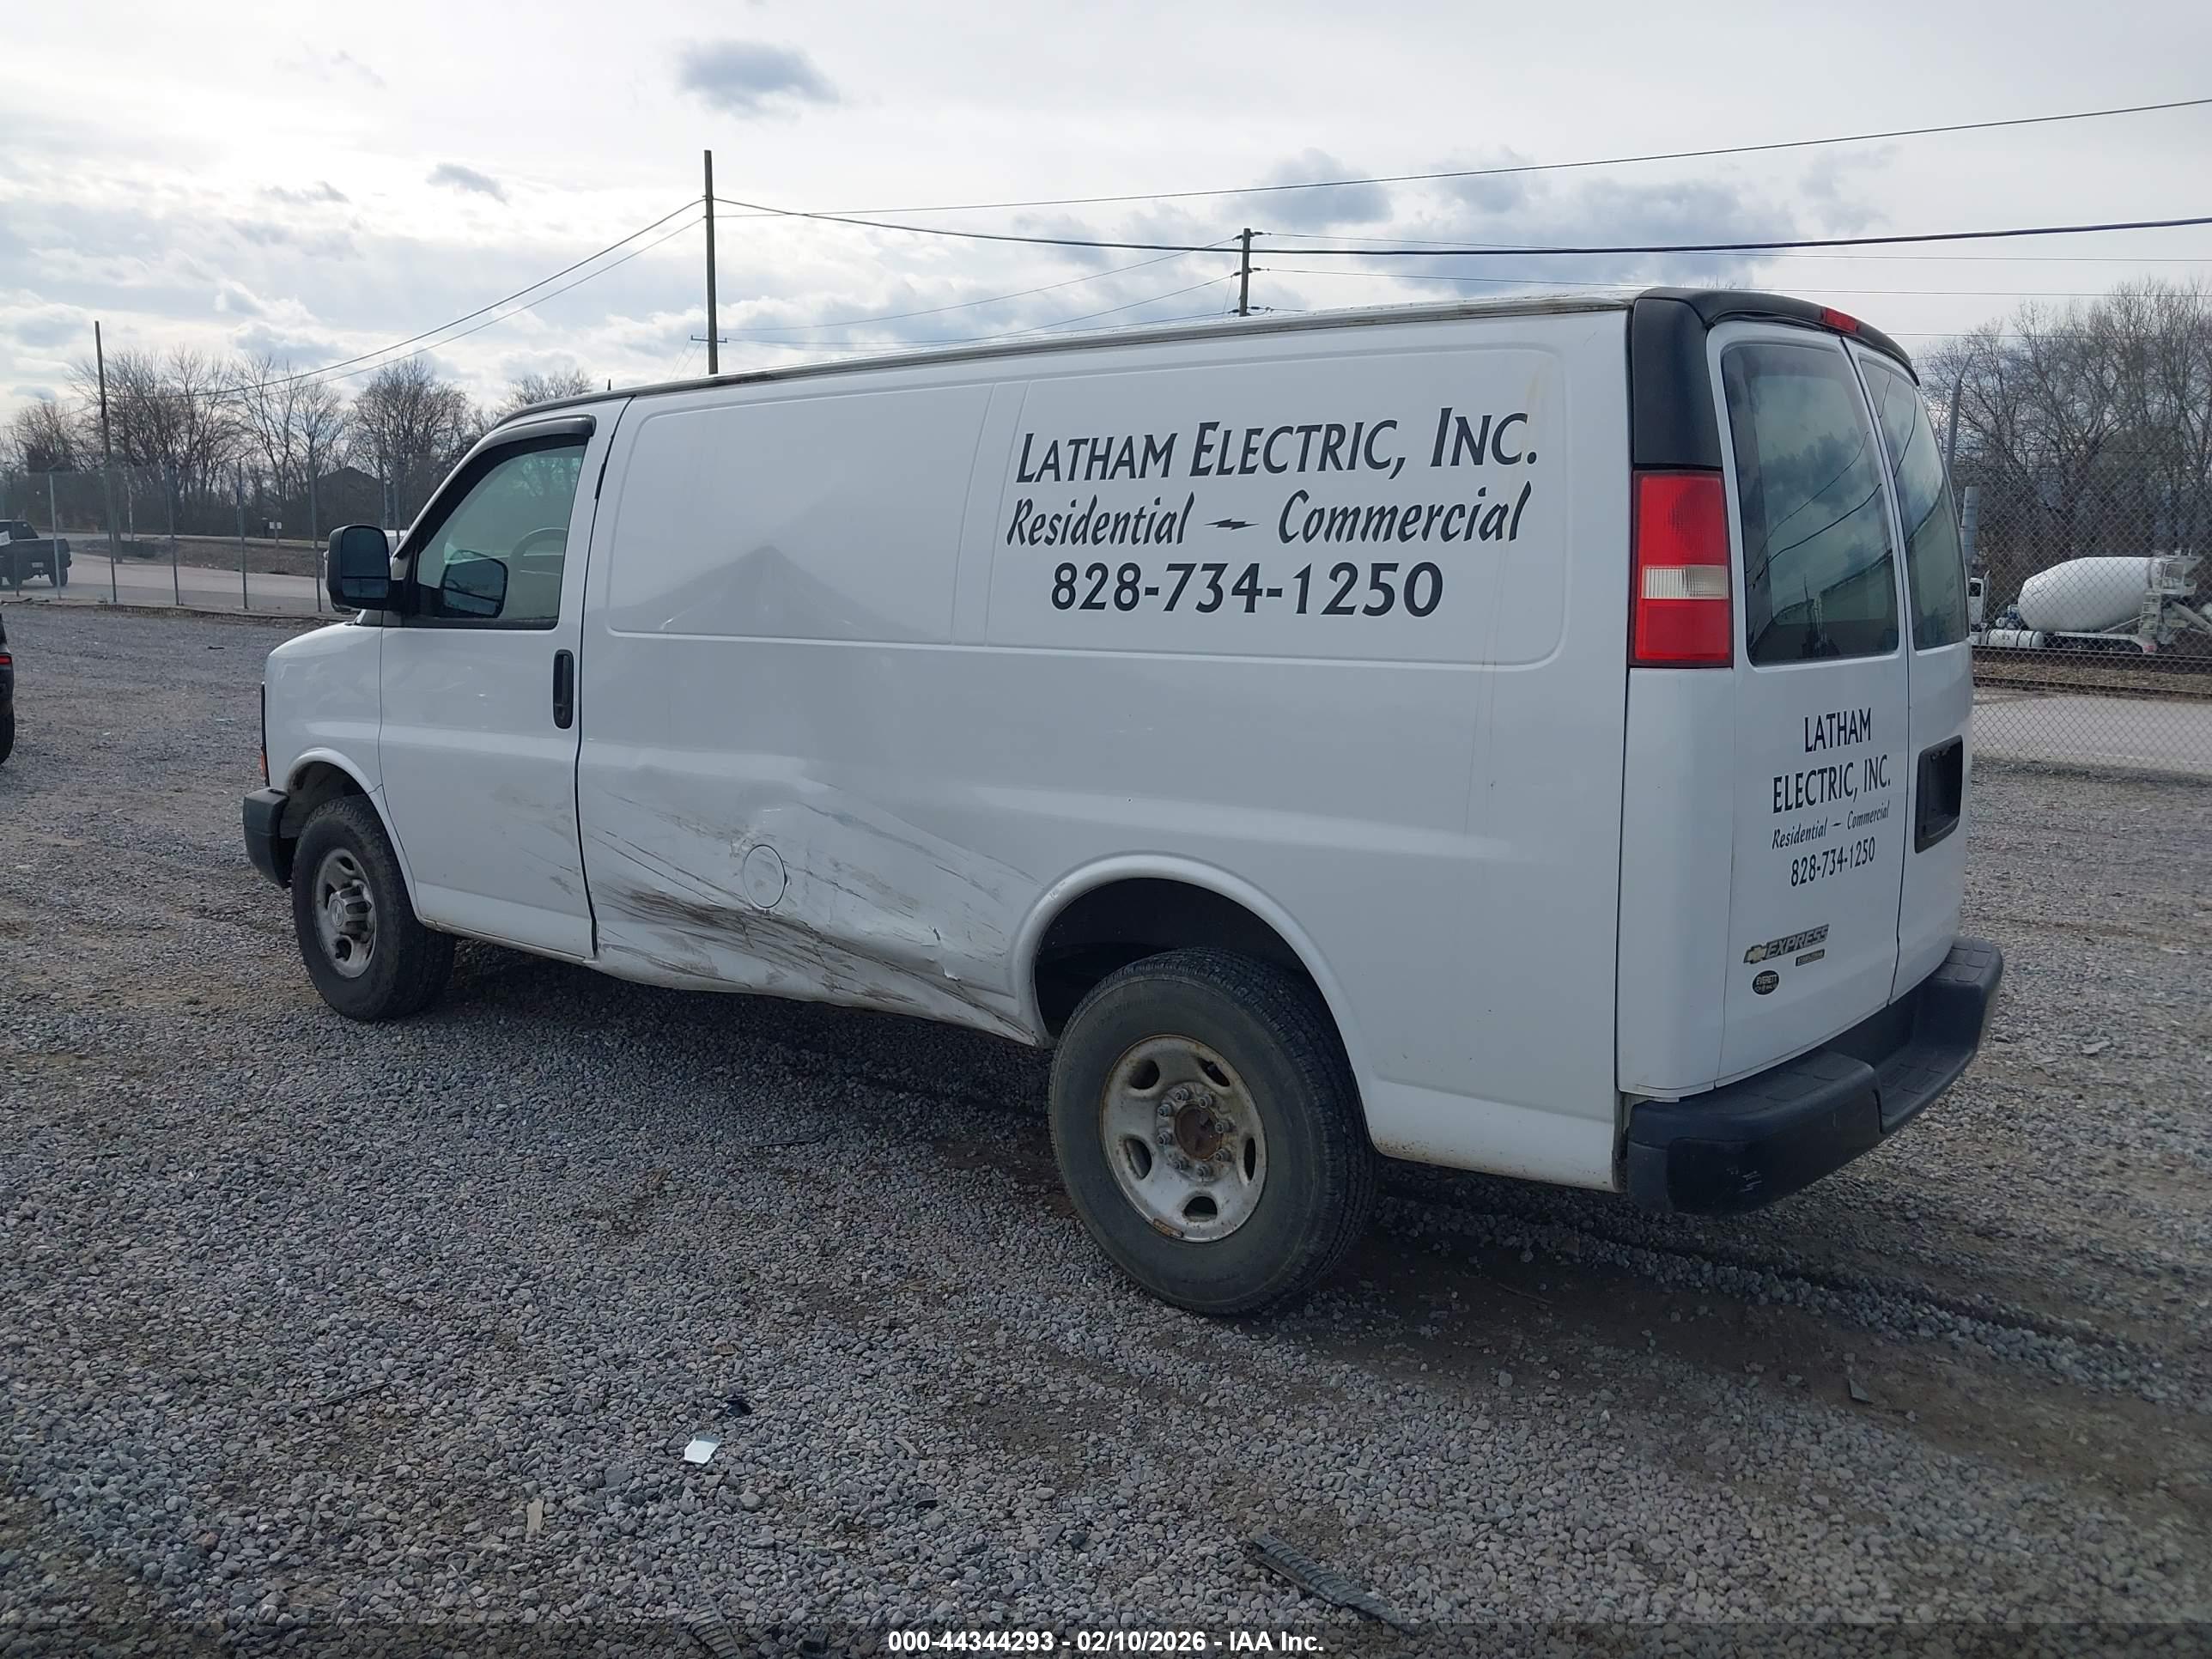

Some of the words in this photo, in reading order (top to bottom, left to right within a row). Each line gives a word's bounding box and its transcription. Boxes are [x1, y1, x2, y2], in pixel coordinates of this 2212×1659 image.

[1016, 432, 1178, 483] LATHAM
[1188, 419, 1407, 480] ELECTRIC,
[1430, 407, 1538, 468] INC.
[1006, 491, 1195, 546] Residential
[1278, 480, 1533, 544] Commercial
[1051, 562, 1443, 617] 828-734-1250
[1804, 707, 1872, 753] LATHAM
[1772, 761, 1858, 814] ELECTRIC,
[1863, 754, 1891, 795] INC.
[1771, 817, 1828, 850] Residential
[1847, 800, 1890, 831] Commercial
[1790, 836, 1875, 887] 828-734-1250
[1765, 926, 1828, 960] EXPRESS
